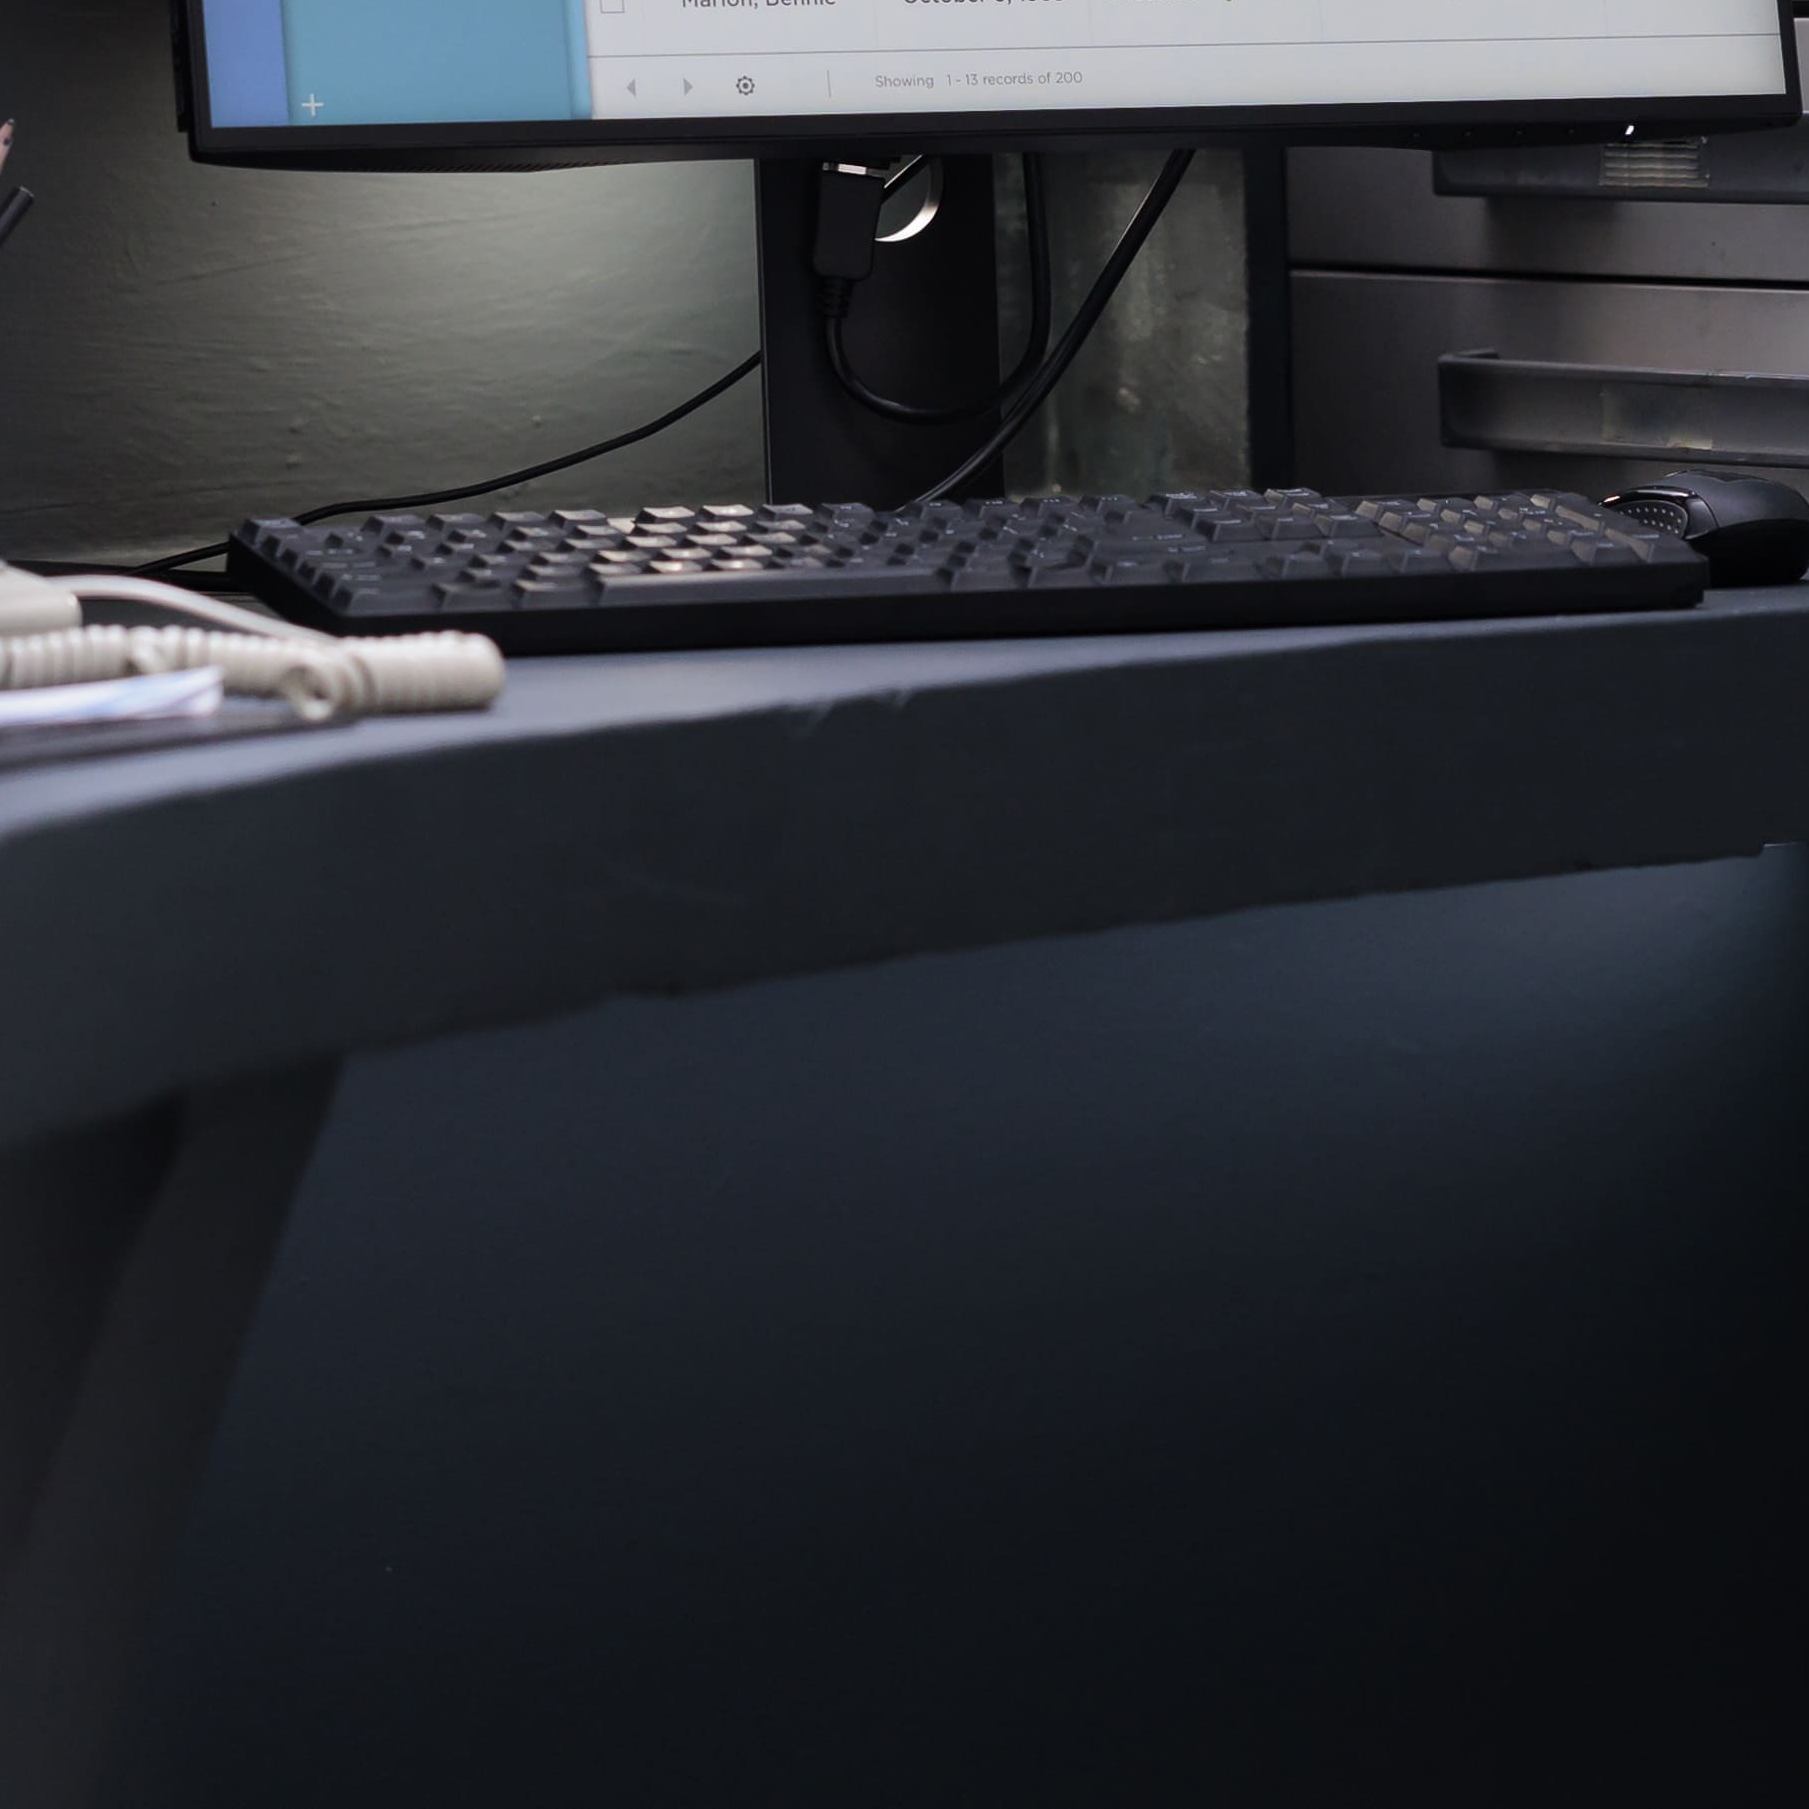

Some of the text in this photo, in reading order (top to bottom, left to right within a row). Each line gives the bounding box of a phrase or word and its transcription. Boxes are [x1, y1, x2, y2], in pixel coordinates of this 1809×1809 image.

[875, 74, 935, 90] Showing
[965, 71, 979, 86] 13
[982, 72, 1034, 87] records
[1037, 71, 1052, 85] of
[1055, 69, 1083, 84] 200
